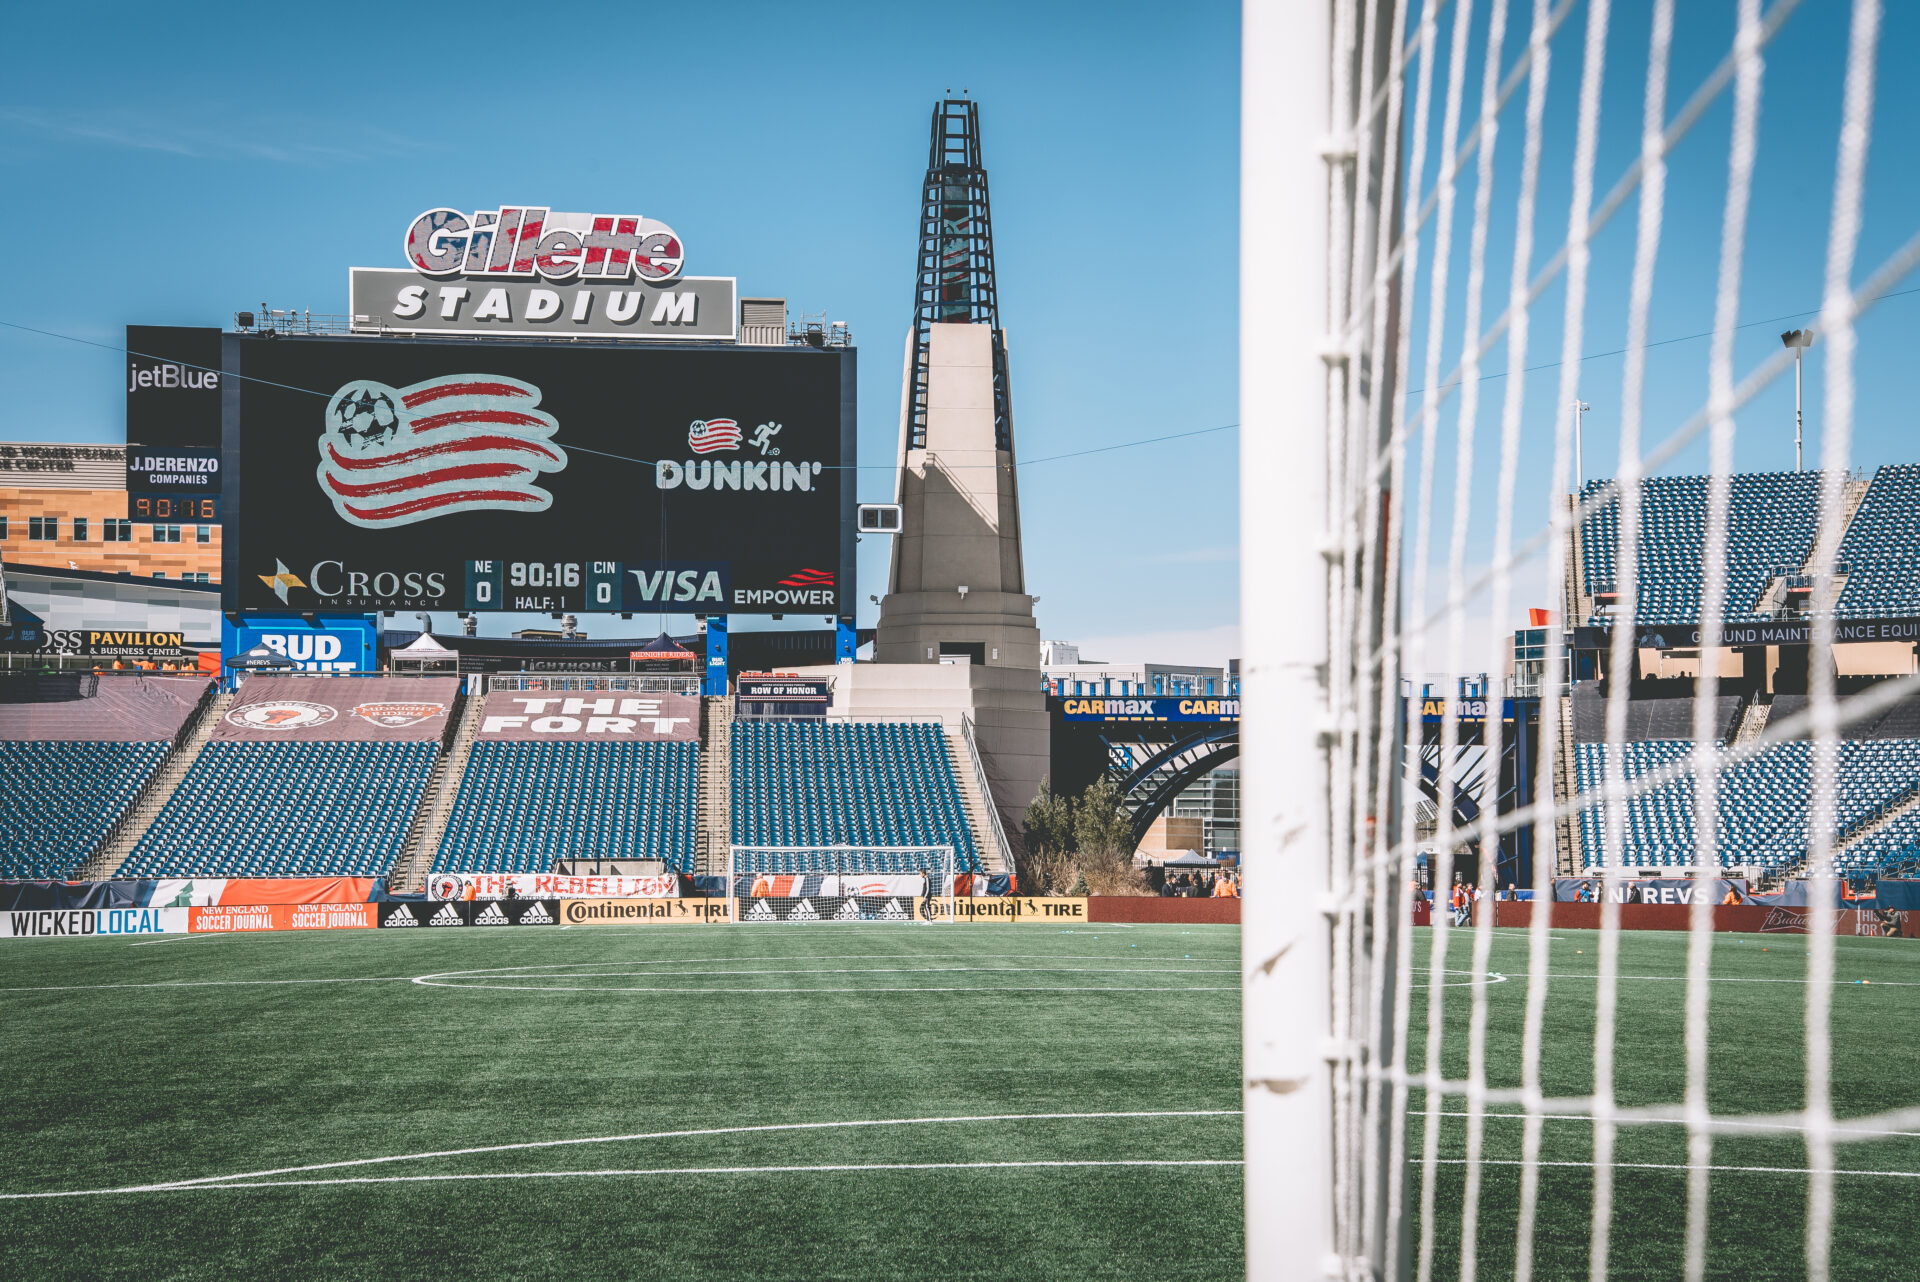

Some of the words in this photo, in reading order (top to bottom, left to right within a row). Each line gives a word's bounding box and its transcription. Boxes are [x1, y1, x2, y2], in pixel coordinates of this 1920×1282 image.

[405, 206, 684, 281] Gillette
[393, 286, 699, 324] STADIUM
[129, 364, 218, 392] jetBlue
[130, 457, 218, 472] J.DERENZO
[149, 474, 208, 484] COMPANIES
[656, 459, 822, 491] DUNKIN'
[137, 499, 214, 518] 90:16
[475, 561, 492, 573] NE
[511, 562, 580, 587] 90:16
[594, 561, 615, 573] CIN
[310, 560, 446, 597] CROSS
[628, 570, 724, 602] VISA
[476, 582, 491, 602] 0
[597, 582, 611, 603] 0
[734, 590, 835, 605] EMPOWER
[319, 599, 441, 607] INSURANCE
[515, 597, 555, 609] HALF:
[41, 631, 82, 648] OSS
[90, 632, 182, 646] PAVILION
[1691, 630, 1756, 643] GOUND
[1761, 625, 1875, 641] MAINTEANCE
[1881, 623, 1920, 637] EQUI
[101, 647, 143, 655] BUSINESS
[262, 634, 342, 661] BUD
[751, 687, 771, 695] ROW
[773, 687, 784, 695] OF
[786, 687, 817, 695] HONOR
[513, 698, 663, 715] THE
[1064, 700, 1154, 715] CARmax
[1179, 700, 1239, 715] CARm
[481, 716, 689, 734] FORT
[471, 875, 522, 893] THE
[536, 874, 674, 896] REBELLION
[1608, 887, 1708, 904] NREVS
[202, 907, 224, 915] NEW
[226, 905, 268, 914] ENGLAND
[298, 904, 320, 913] NEW
[321, 903, 363, 912] ENGLAND
[566, 901, 671, 923] Continental
[788, 911, 820, 920] adidas
[1042, 904, 1082, 916] TIRE
[197, 915, 230, 930] SOCCER
[232, 914, 274, 931] JOURNAL
[292, 913, 326, 928] SOCCER
[328, 912, 368, 929] JOURNAL
[384, 917, 418, 927] adidas
[429, 917, 463, 926] adidas
[475, 916, 509, 925] adidas
[520, 915, 553, 924] adidas
[744, 912, 777, 921] adidas
